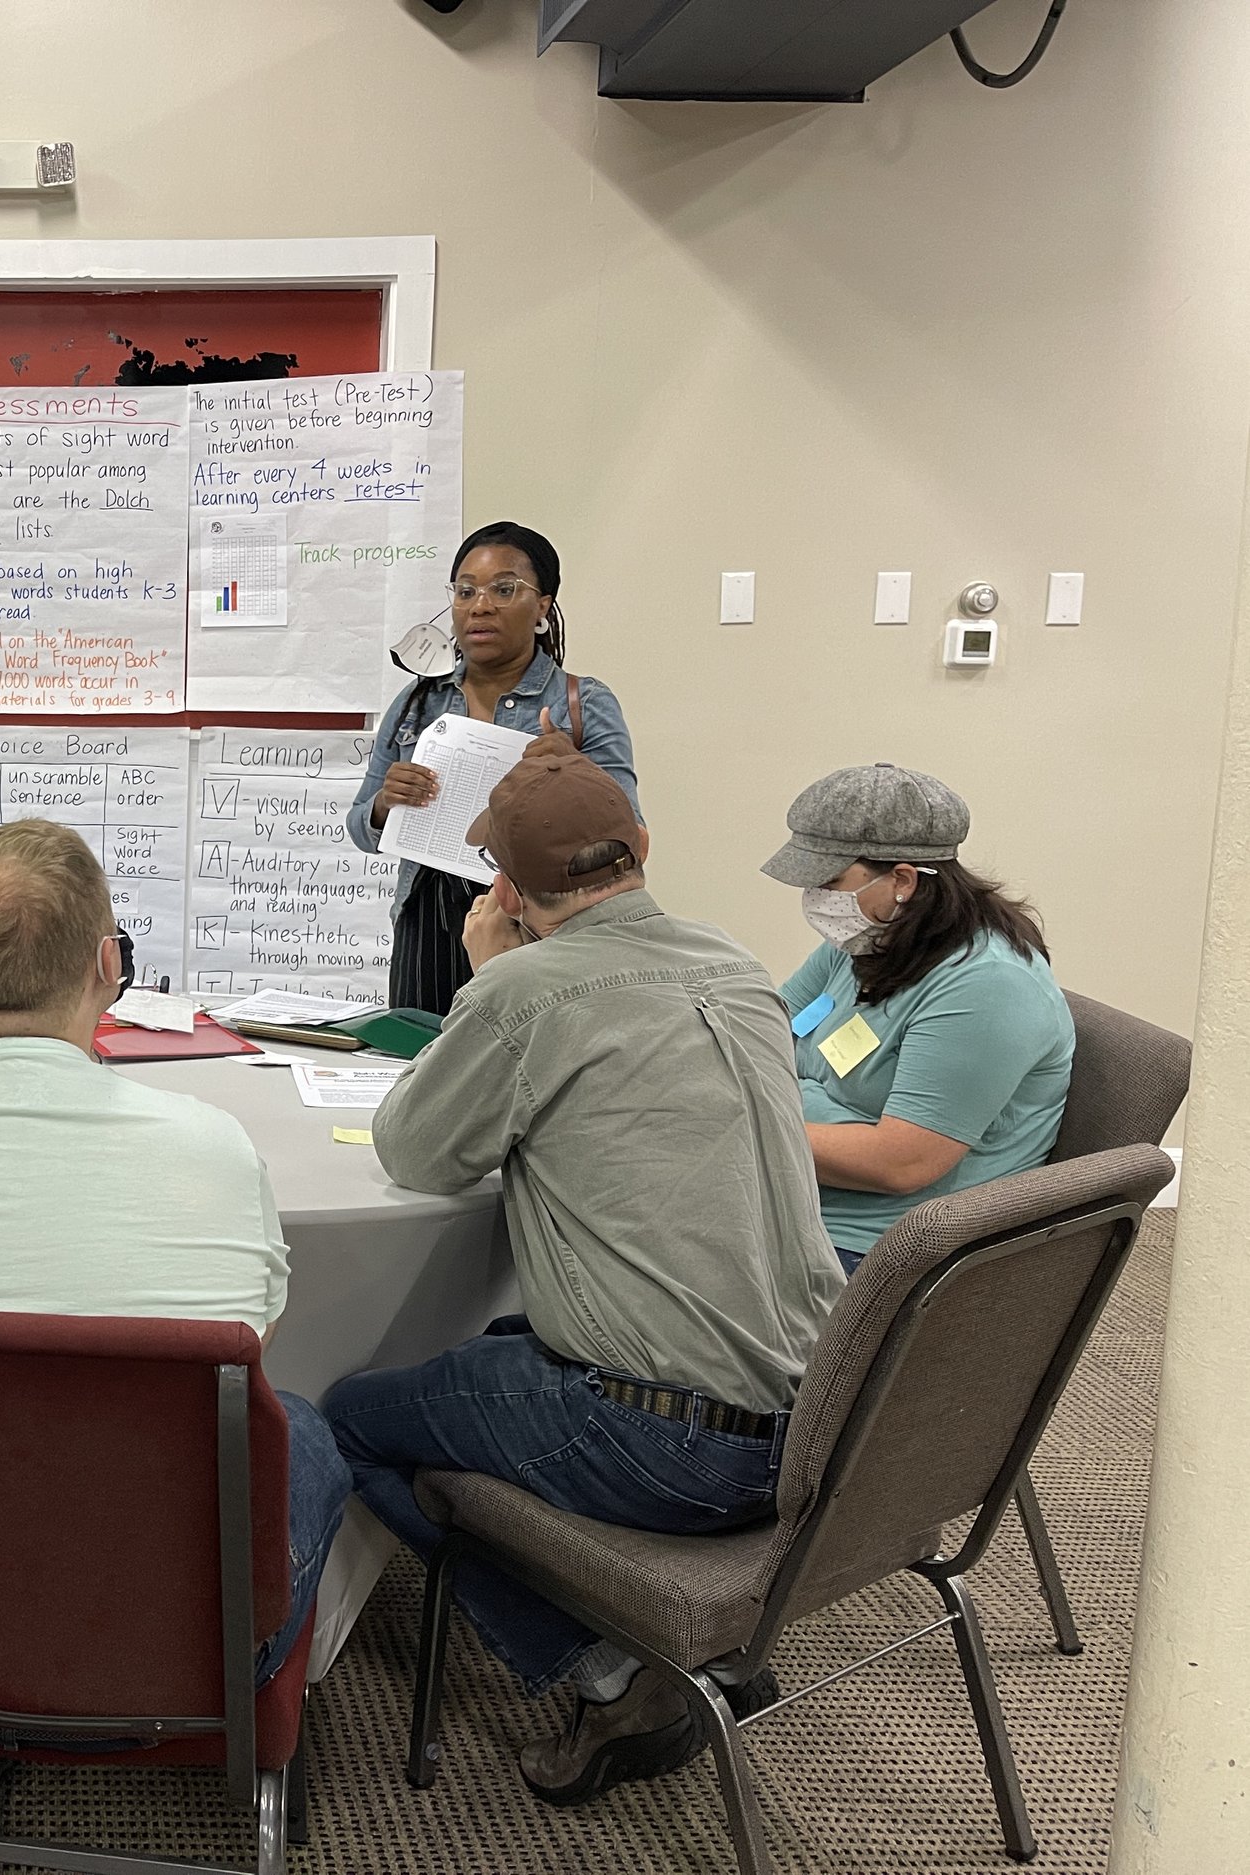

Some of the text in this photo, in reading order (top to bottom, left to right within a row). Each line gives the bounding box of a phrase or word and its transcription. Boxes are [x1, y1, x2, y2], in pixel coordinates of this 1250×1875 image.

[193, 374, 434, 411] The initial test (Pre-Test)
[205, 407, 433, 439] is given before beginning
[27, 426, 50, 446] of
[62, 426, 116, 454] sight
[127, 429, 169, 447] word
[29, 458, 91, 484] popular
[98, 463, 147, 483] among
[193, 456, 431, 487] After every 4 weeks in
[13, 495, 44, 508] are
[59, 491, 91, 508] the
[106, 488, 150, 509] Dolch
[194, 489, 259, 514] learning
[271, 482, 335, 504] centers
[294, 541, 438, 568] Track progress
[57, 567, 77, 579] on
[95, 558, 133, 585] high
[11, 586, 53, 600] words
[65, 584, 129, 600] students
[9, 637, 24, 649] on
[33, 628, 57, 649] the
[4, 651, 38, 669] Word
[53, 649, 119, 675] Frequency
[35, 671, 73, 689] words
[125, 672, 139, 689] in
[69, 690, 86, 707] for
[93, 694, 132, 712] grades
[66, 734, 128, 756] Board
[220, 733, 324, 778] Learning
[121, 769, 156, 785] ABC
[117, 791, 164, 806] order
[211, 785, 235, 814] V
[323, 799, 338, 815] is
[117, 827, 163, 844] Sight
[255, 816, 275, 842] by
[113, 845, 152, 859] Word
[207, 845, 223, 872] A
[336, 855, 351, 873] is
[116, 862, 160, 876] Race
[229, 877, 288, 900] through
[230, 897, 256, 913] and
[203, 920, 390, 947] K Kinesthetic is
[250, 948, 308, 973] through
[318, 952, 364, 970] moving
